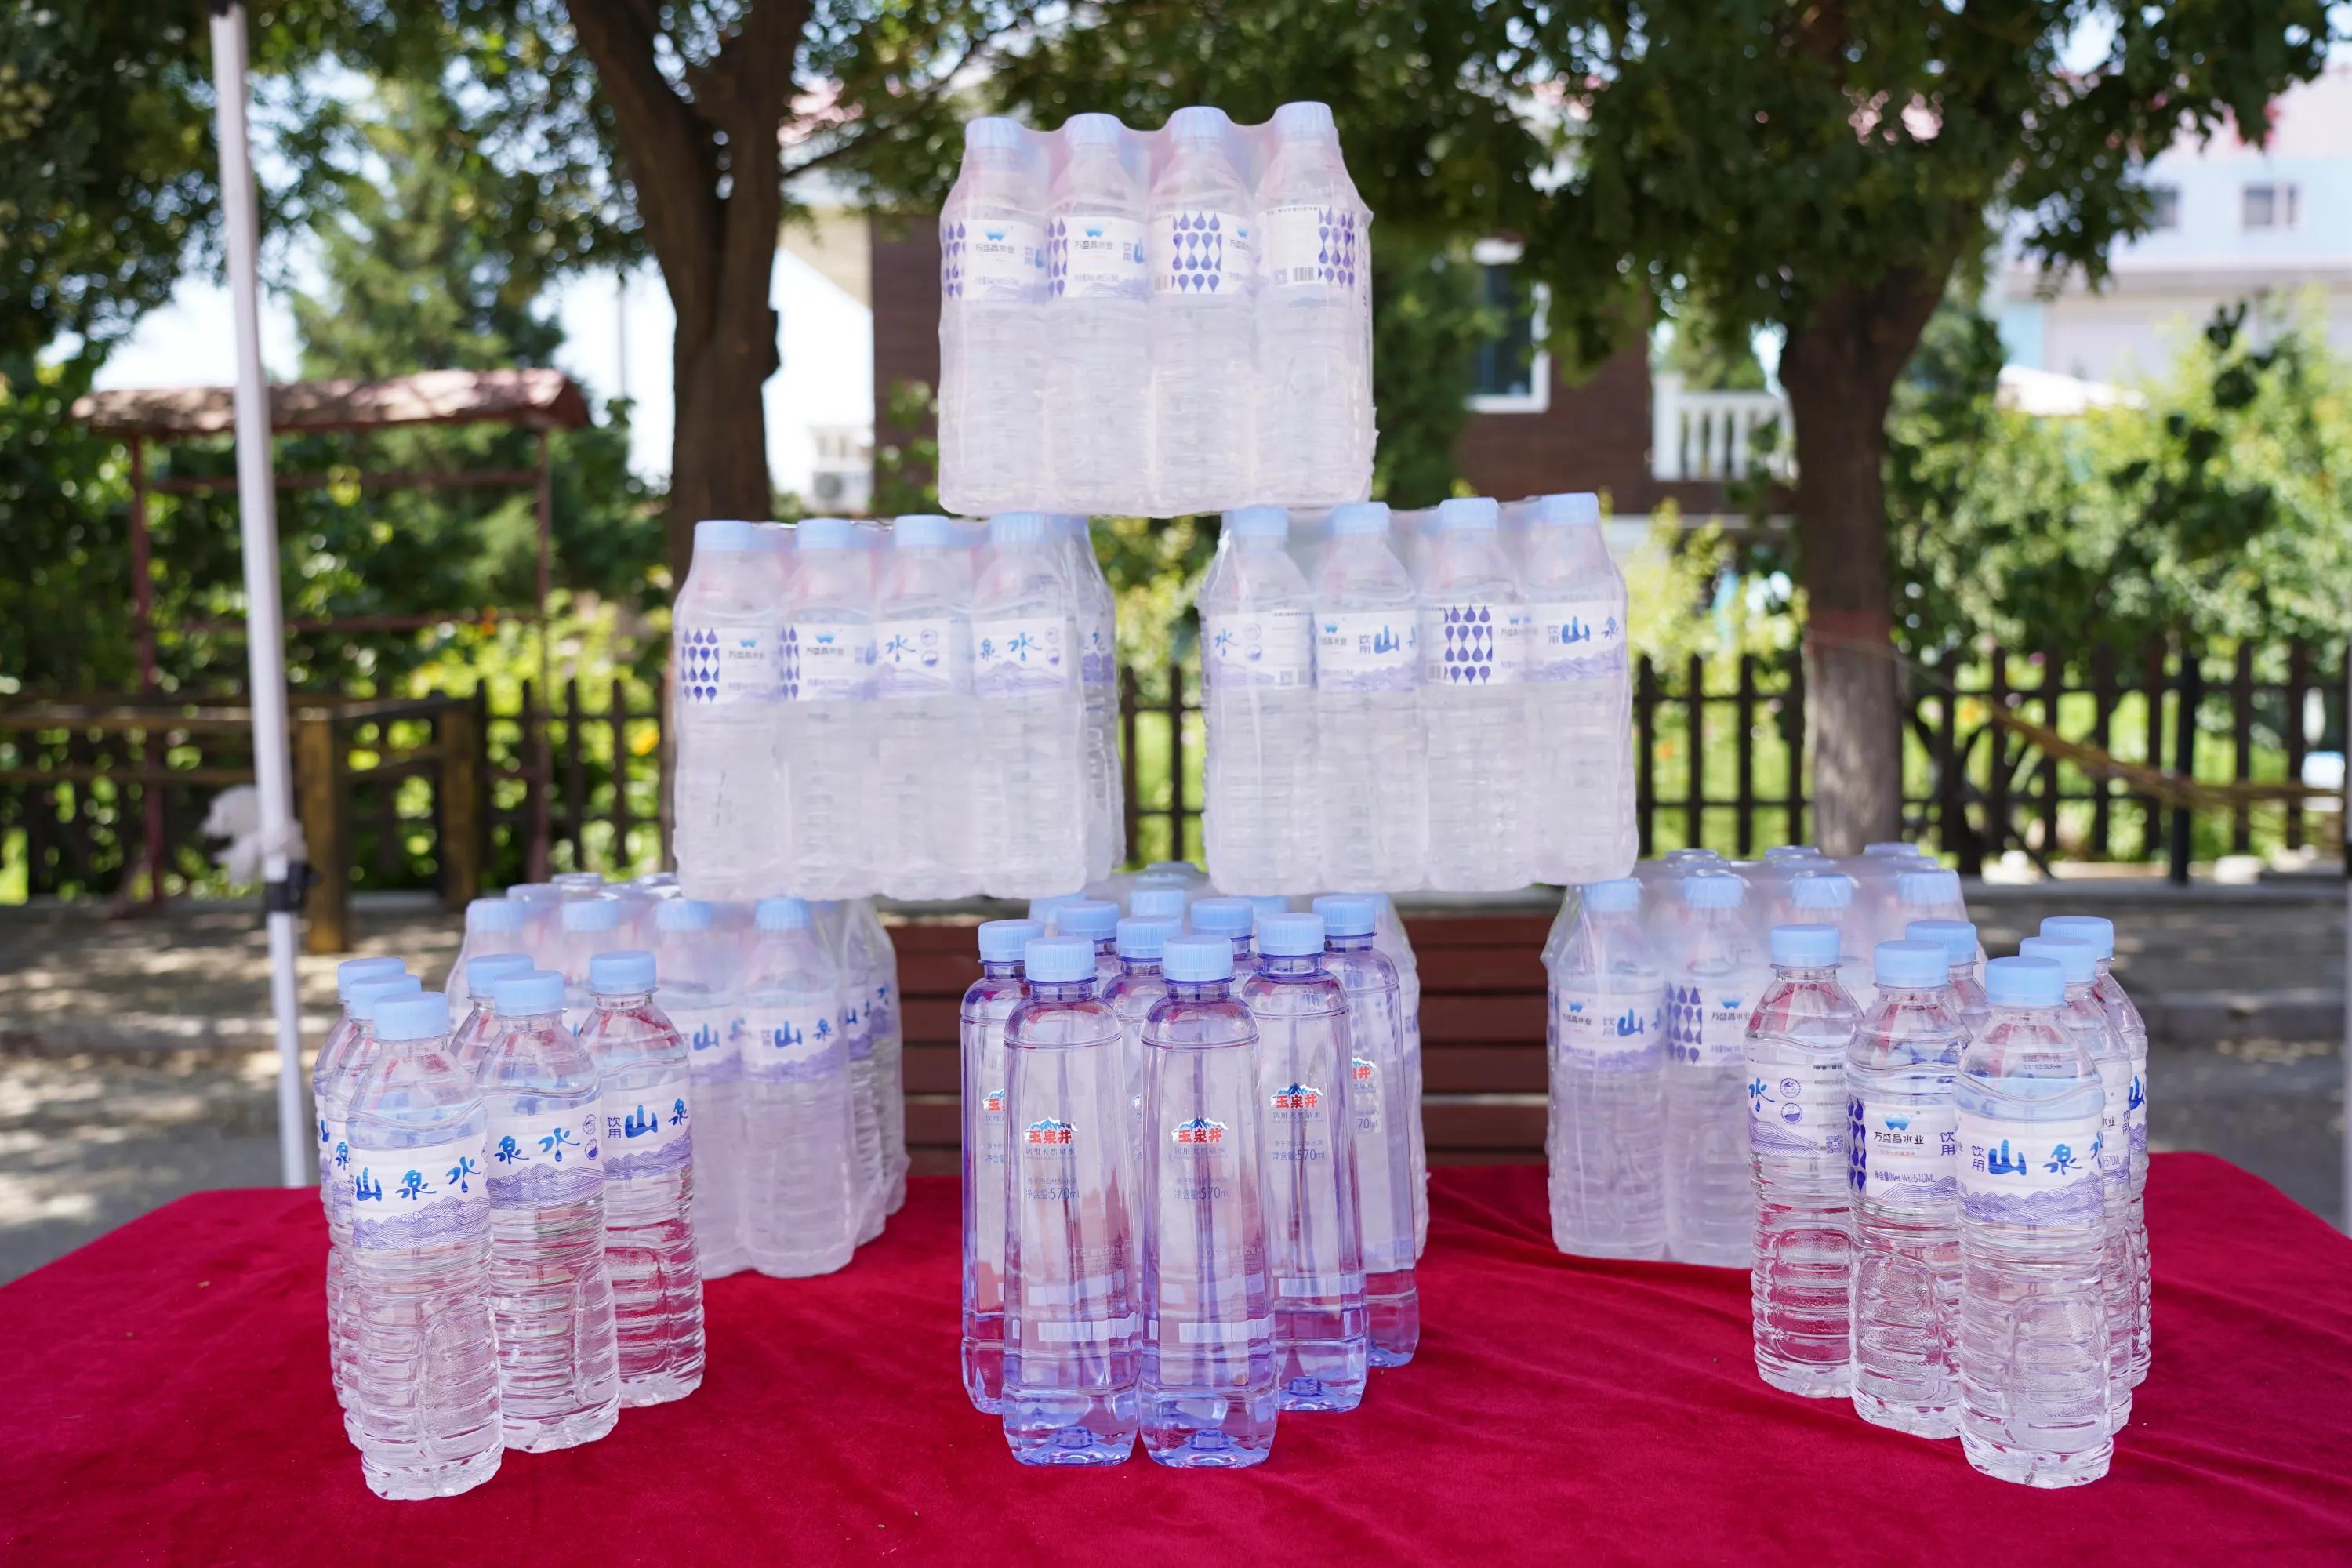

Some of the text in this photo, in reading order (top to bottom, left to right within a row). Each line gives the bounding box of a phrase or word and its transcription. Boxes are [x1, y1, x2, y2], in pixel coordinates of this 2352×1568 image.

[1276, 1094, 1318, 1109] 玉泉井
[607, 1117, 622, 1139] 饮用
[625, 1098, 689, 1138] 山泉
[495, 1127, 580, 1165] 泉水
[1029, 1129, 1072, 1144] 玉泉井
[1178, 1127, 1222, 1143] 玉泉井
[1874, 1131, 1925, 1145] 万盛昌水业
[1939, 1132, 1955, 1156] 饮用
[1971, 1144, 1985, 1172] 饮用
[356, 1156, 481, 1202] 山泉水
